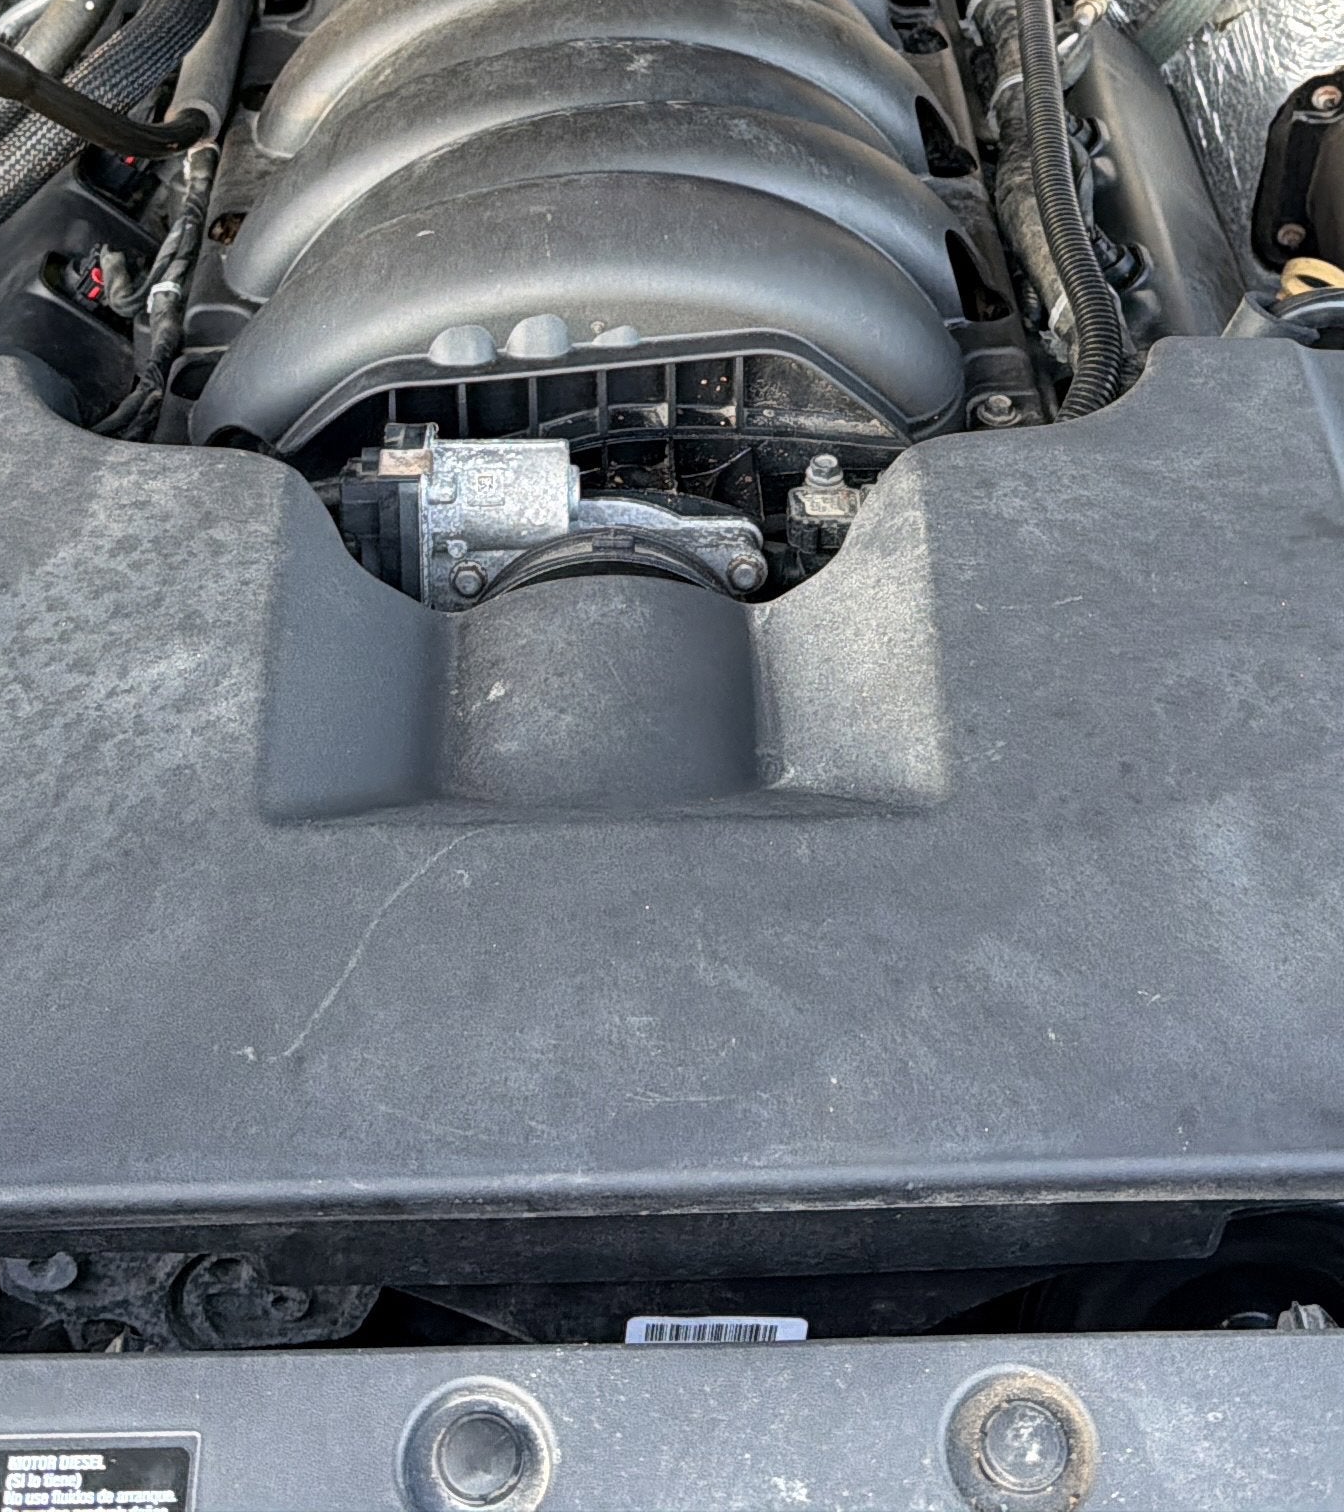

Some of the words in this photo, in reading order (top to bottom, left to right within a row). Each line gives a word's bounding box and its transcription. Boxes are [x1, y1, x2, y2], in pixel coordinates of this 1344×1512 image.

[7, 1455, 57, 1471] MOTOR
[58, 1454, 107, 1470] DIESEL
[3, 1491, 23, 1506] No
[24, 1492, 50, 1505] use
